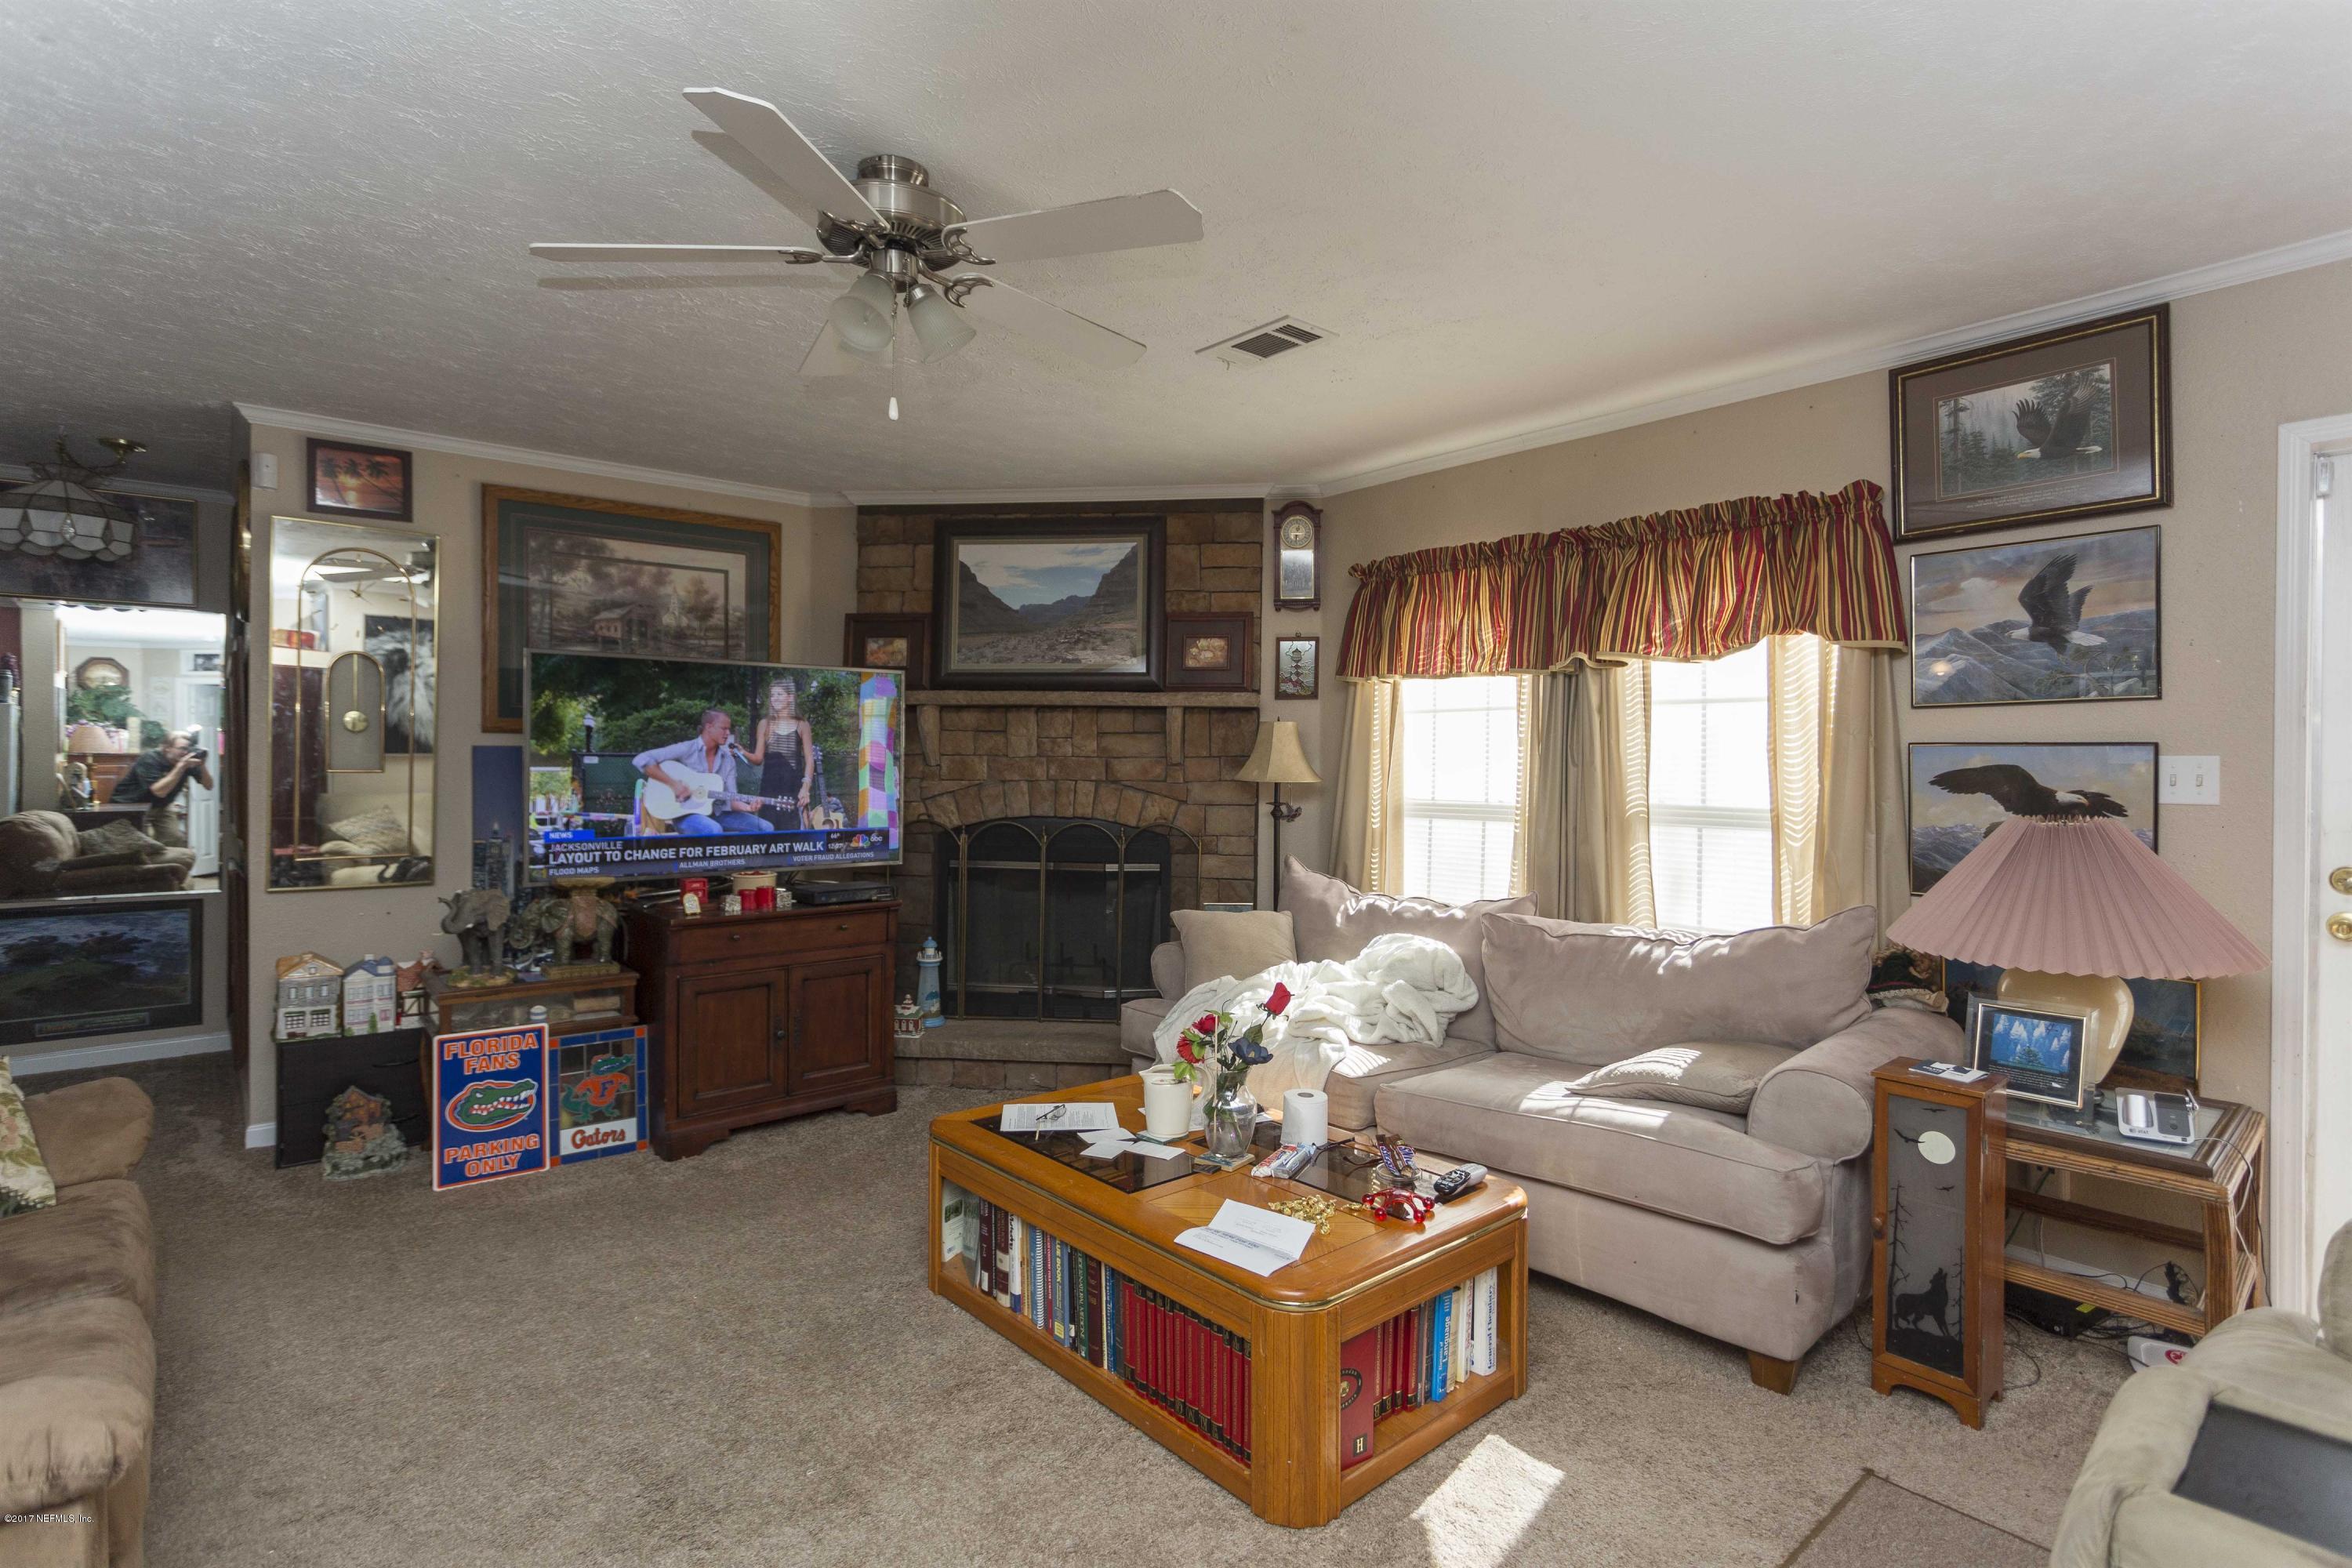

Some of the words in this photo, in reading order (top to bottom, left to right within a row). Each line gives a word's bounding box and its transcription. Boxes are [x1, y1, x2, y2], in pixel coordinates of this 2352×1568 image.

[549, 841, 622, 852] JACKSONVILLE
[549, 851, 602, 865] LAYOUT
[605, 851, 621, 862] TO
[624, 848, 677, 862] CHANGE
[678, 846, 703, 858] FOR
[705, 844, 765, 858] FEBRUARY
[768, 843, 791, 854] ART
[792, 841, 824, 853] WALK
[835, 851, 874, 861] ALLEGATIONS
[549, 866, 575, 876] FLOOD
[576, 866, 600, 874] MAPS
[679, 860, 709, 869] ALLMAN
[709, 858, 746, 868] BROTHERS
[444, 1032, 539, 1060] FLORIDA
[464, 1052, 520, 1075] FANS
[601, 1080, 613, 1098] F
[444, 1133, 540, 1164] PARKING
[571, 1127, 626, 1149] Gators
[465, 1152, 521, 1178] ONLY
[1442, 1315, 1450, 1363] Language
[1356, 1437, 1364, 1454] H
